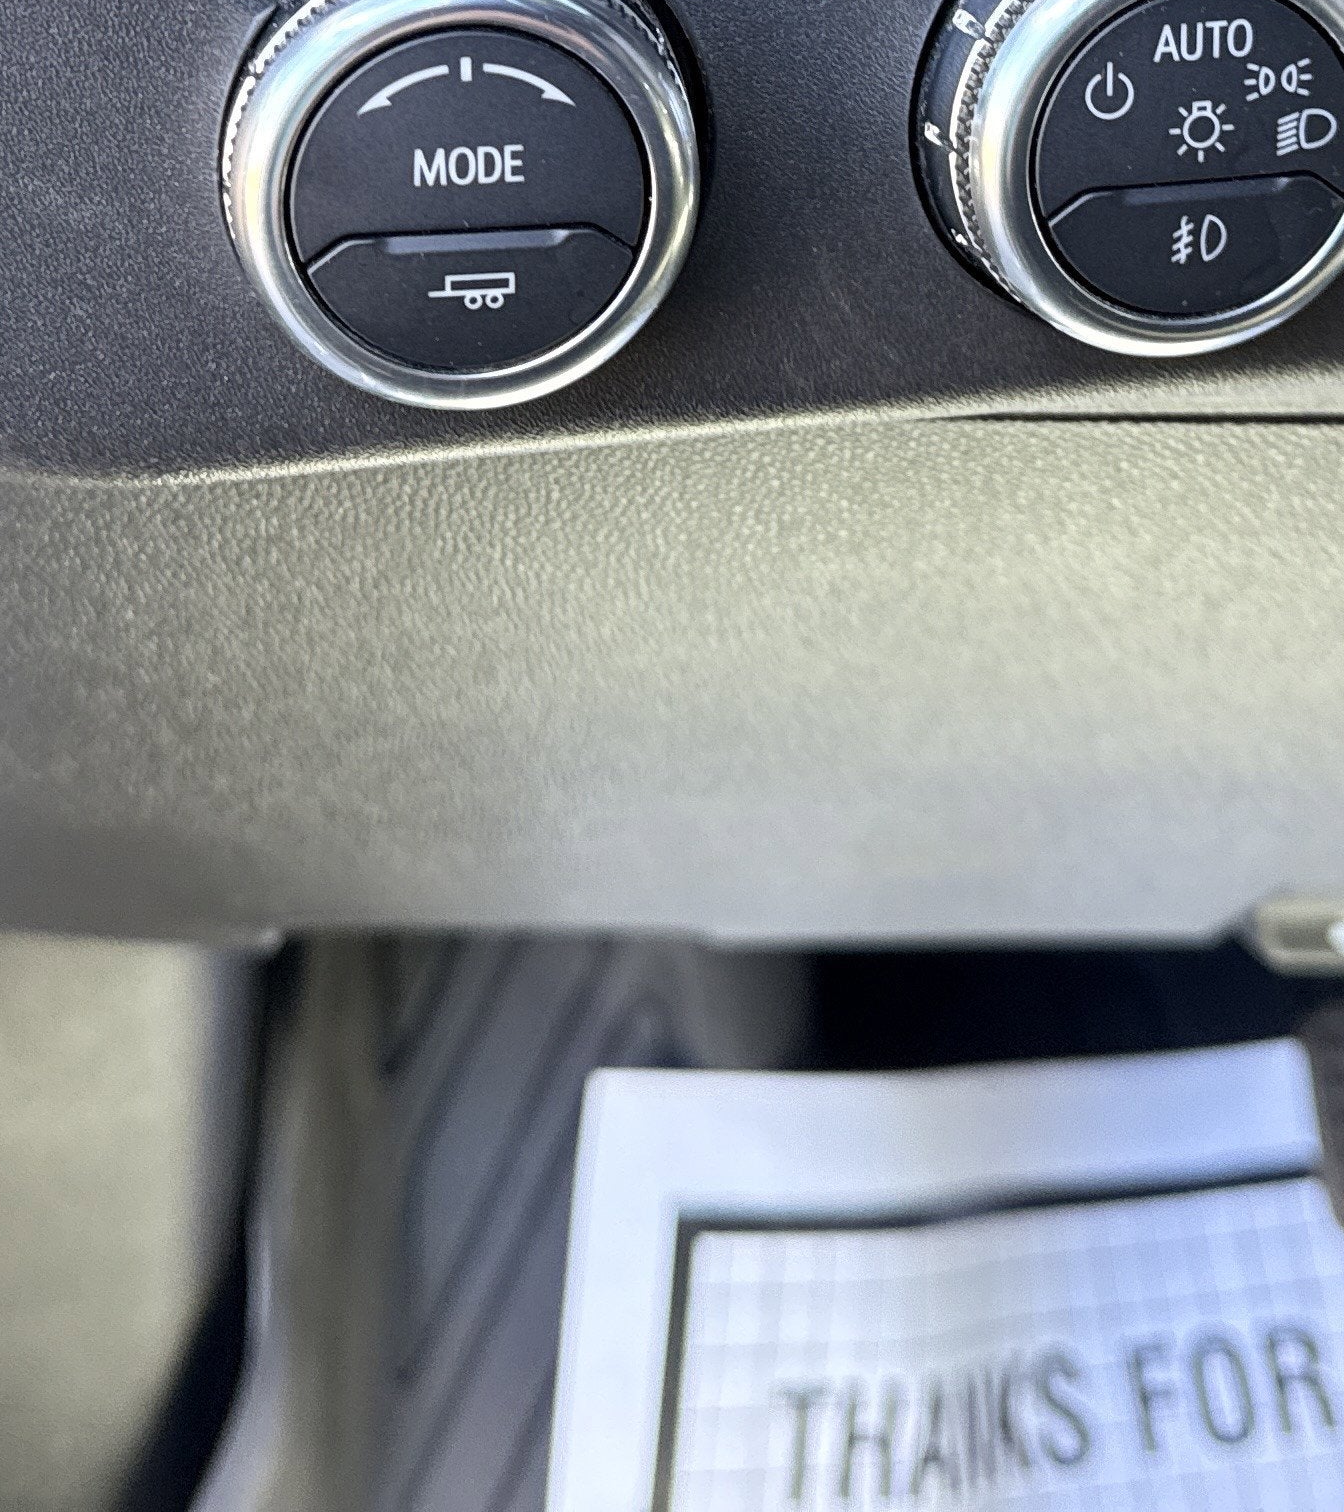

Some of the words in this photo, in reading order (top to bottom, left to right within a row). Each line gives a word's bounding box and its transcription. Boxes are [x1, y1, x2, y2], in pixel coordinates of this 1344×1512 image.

[1153, 18, 1253, 63] AUTO
[413, 144, 525, 187] MODE
[1128, 1326, 1336, 1452] FOR
